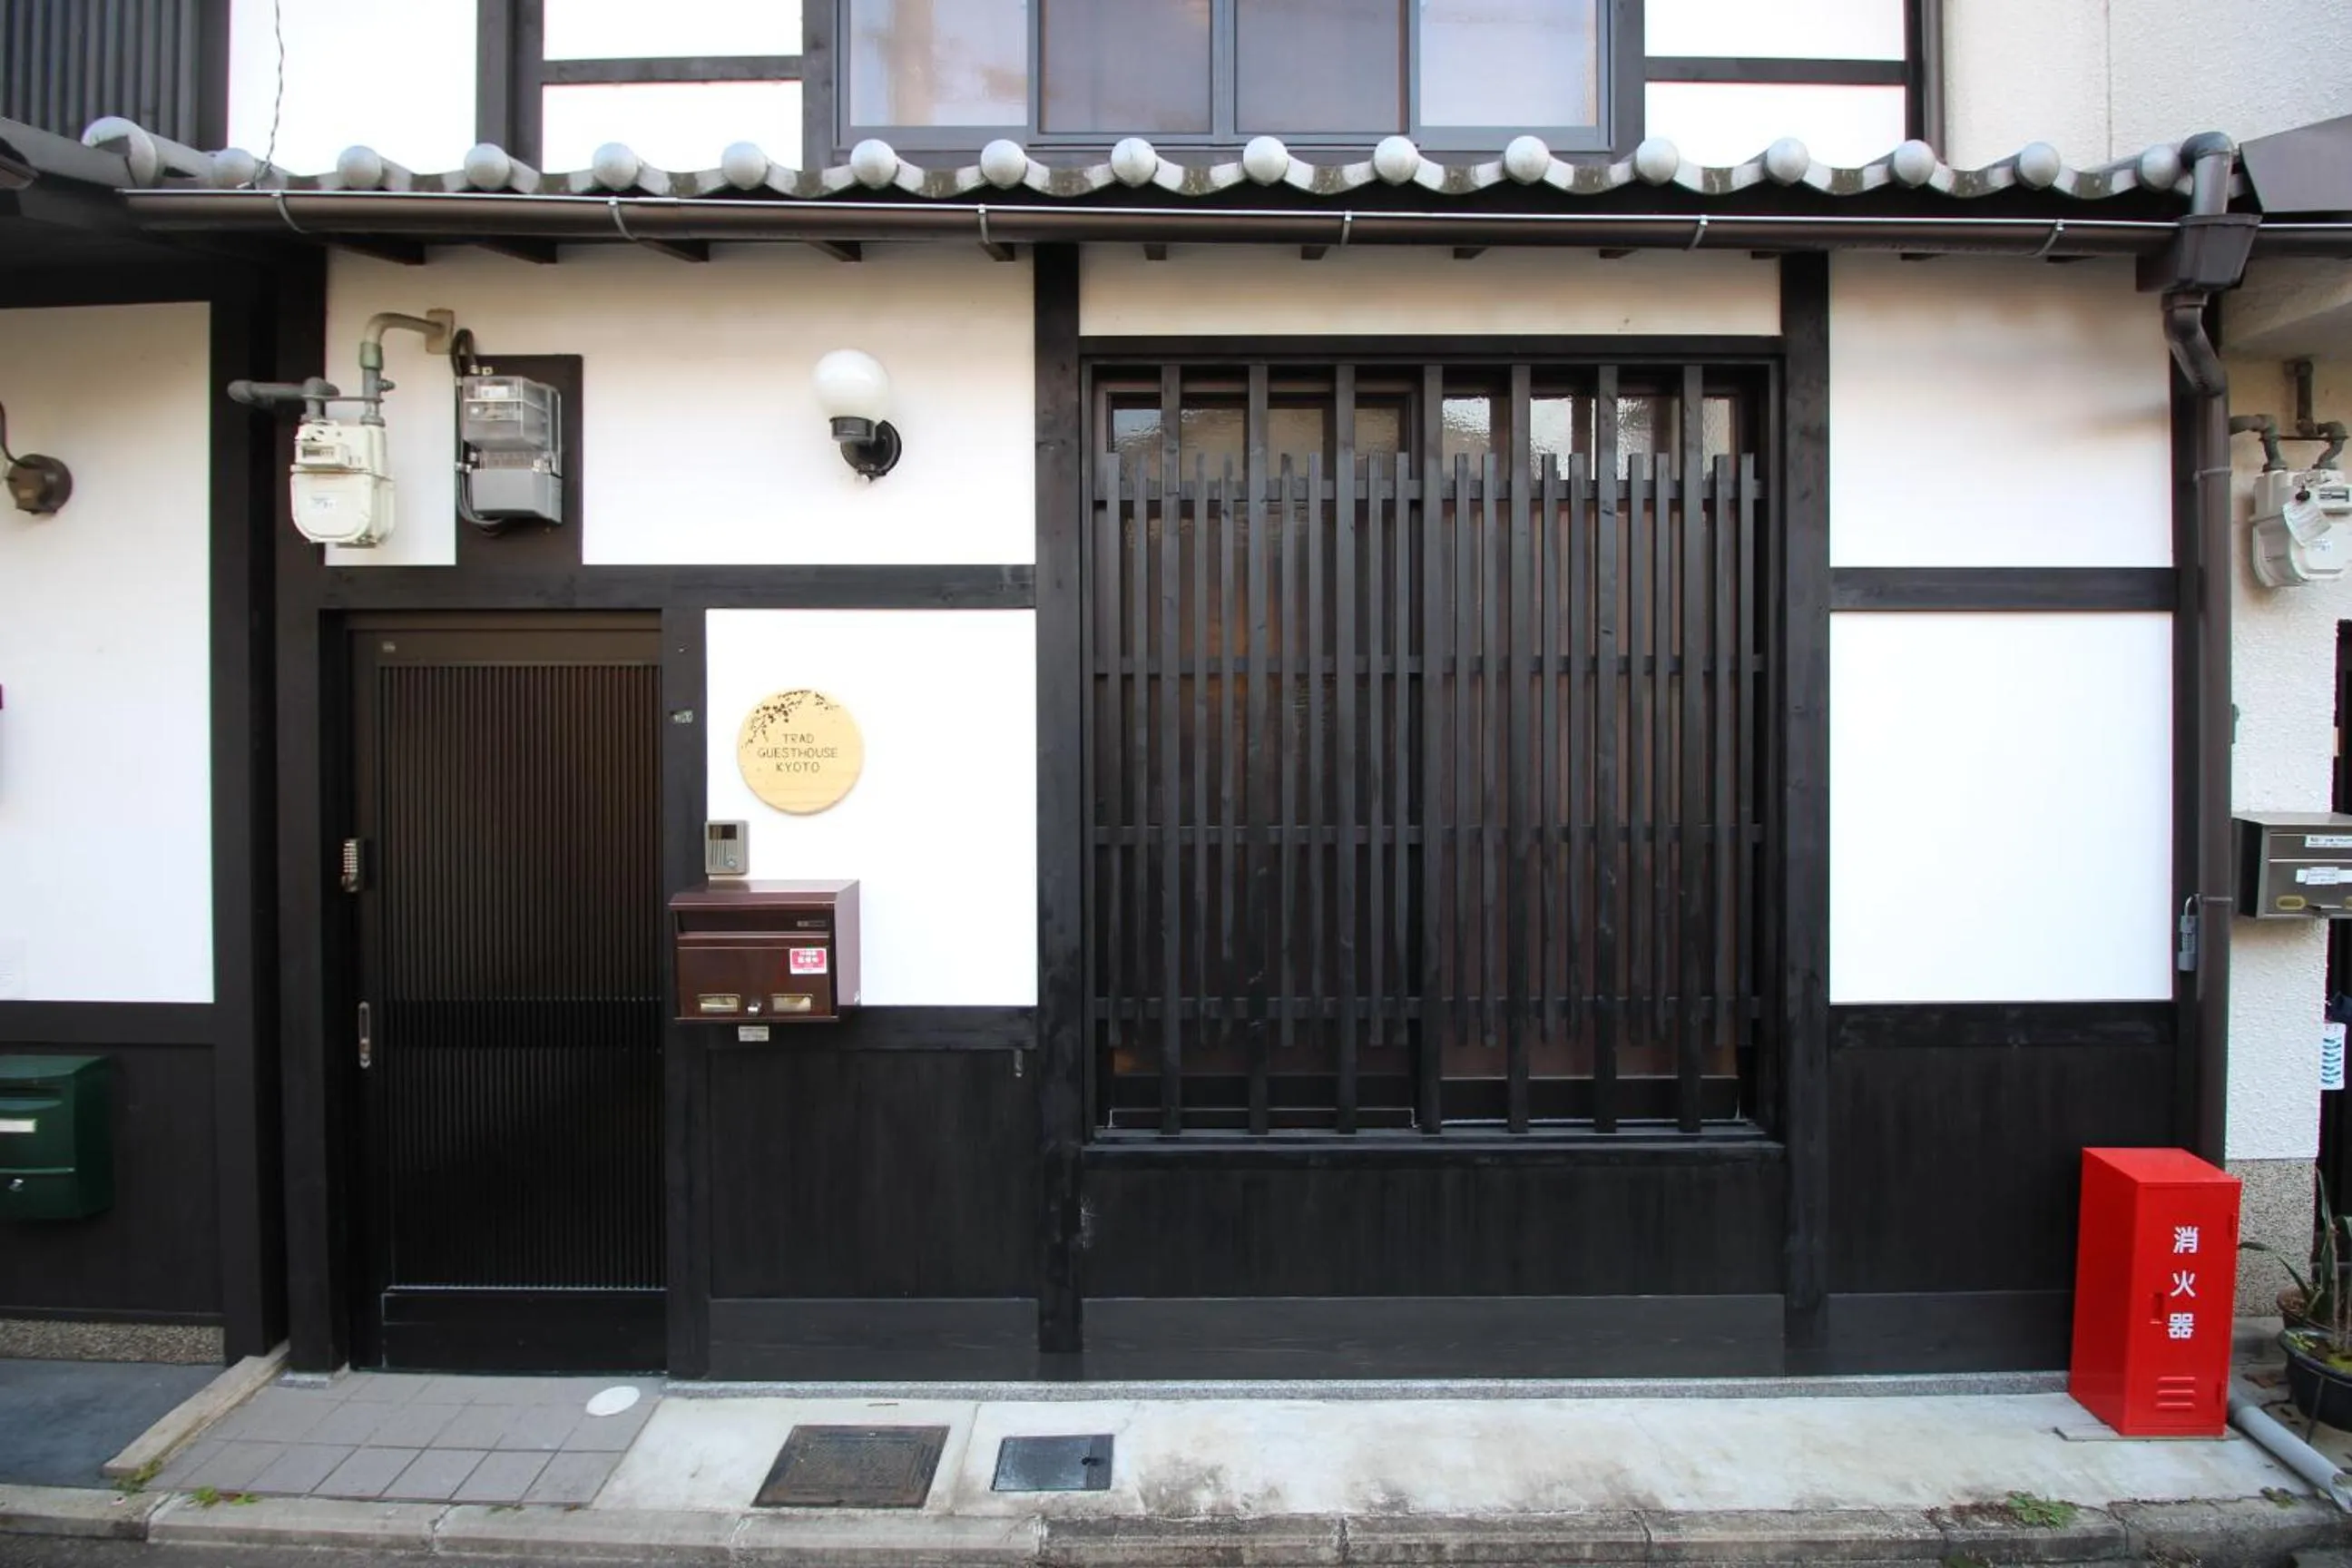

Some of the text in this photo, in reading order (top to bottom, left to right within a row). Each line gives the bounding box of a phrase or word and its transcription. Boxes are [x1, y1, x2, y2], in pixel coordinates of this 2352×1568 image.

[782, 733, 815, 744] TRAD
[757, 747, 838, 759] GUESTHOUSE
[775, 761, 820, 772] KYOTO
[2168, 1226, 2200, 1339] 消火器
